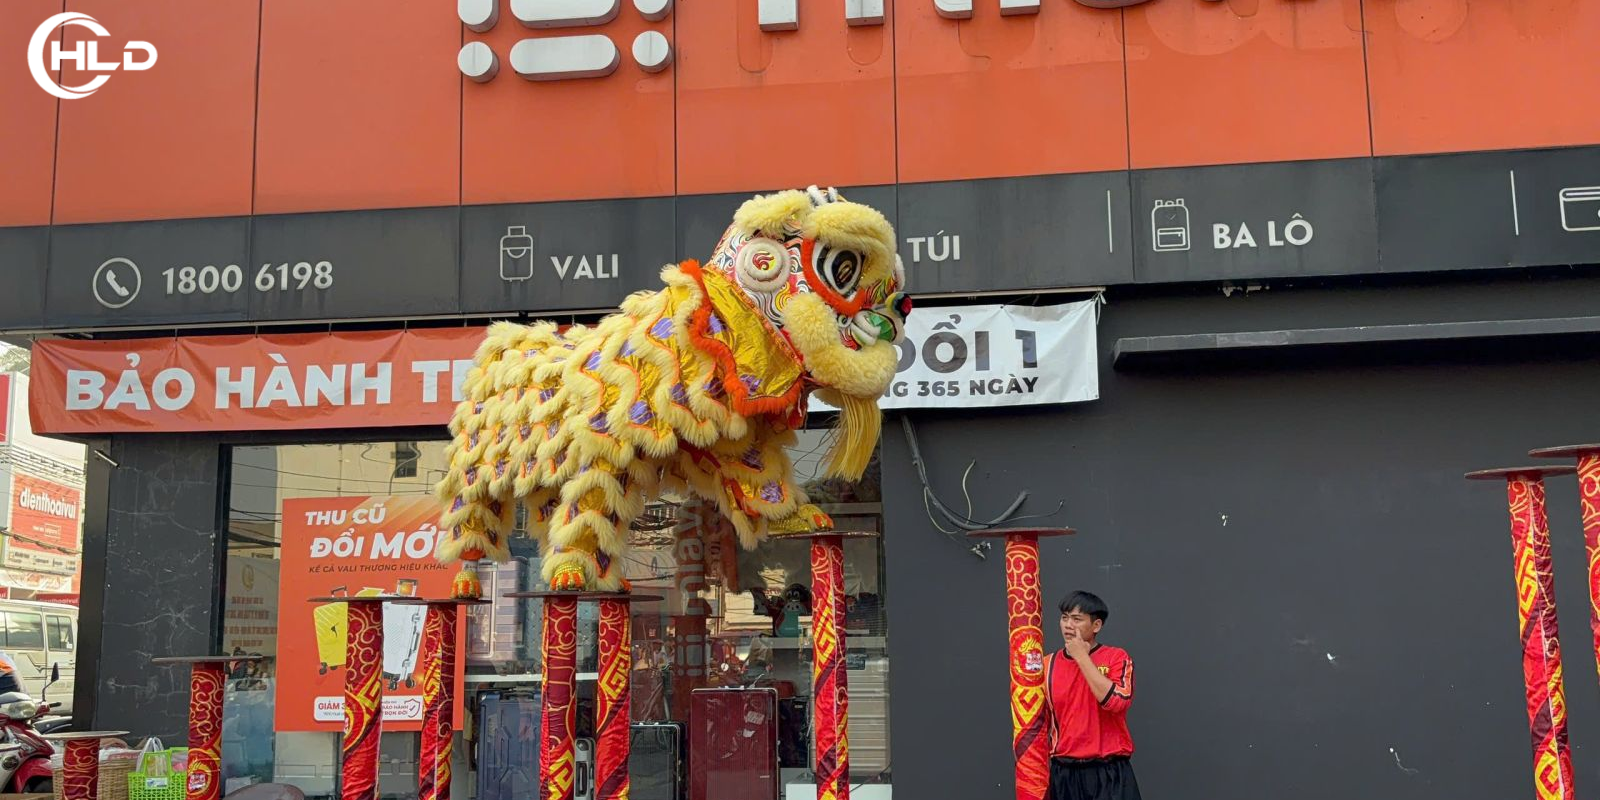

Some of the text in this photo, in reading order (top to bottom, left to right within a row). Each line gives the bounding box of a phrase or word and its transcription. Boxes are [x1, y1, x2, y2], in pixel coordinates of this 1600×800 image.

[906, 229, 960, 262] TÚI
[1213, 212, 1314, 249] BA LÔ
[162, 260, 333, 295] 1800 6198
[550, 253, 618, 280] VALI
[1015, 329, 1038, 368] 1
[65, 352, 196, 411] BẢO
[214, 353, 393, 409] HÀNH
[917, 380, 960, 397] 365
[969, 373, 1038, 396] NGÀY
[305, 503, 386, 526] THU CŨ
[310, 527, 365, 558] ĐỔI
[338, 565, 358, 573] VALI
